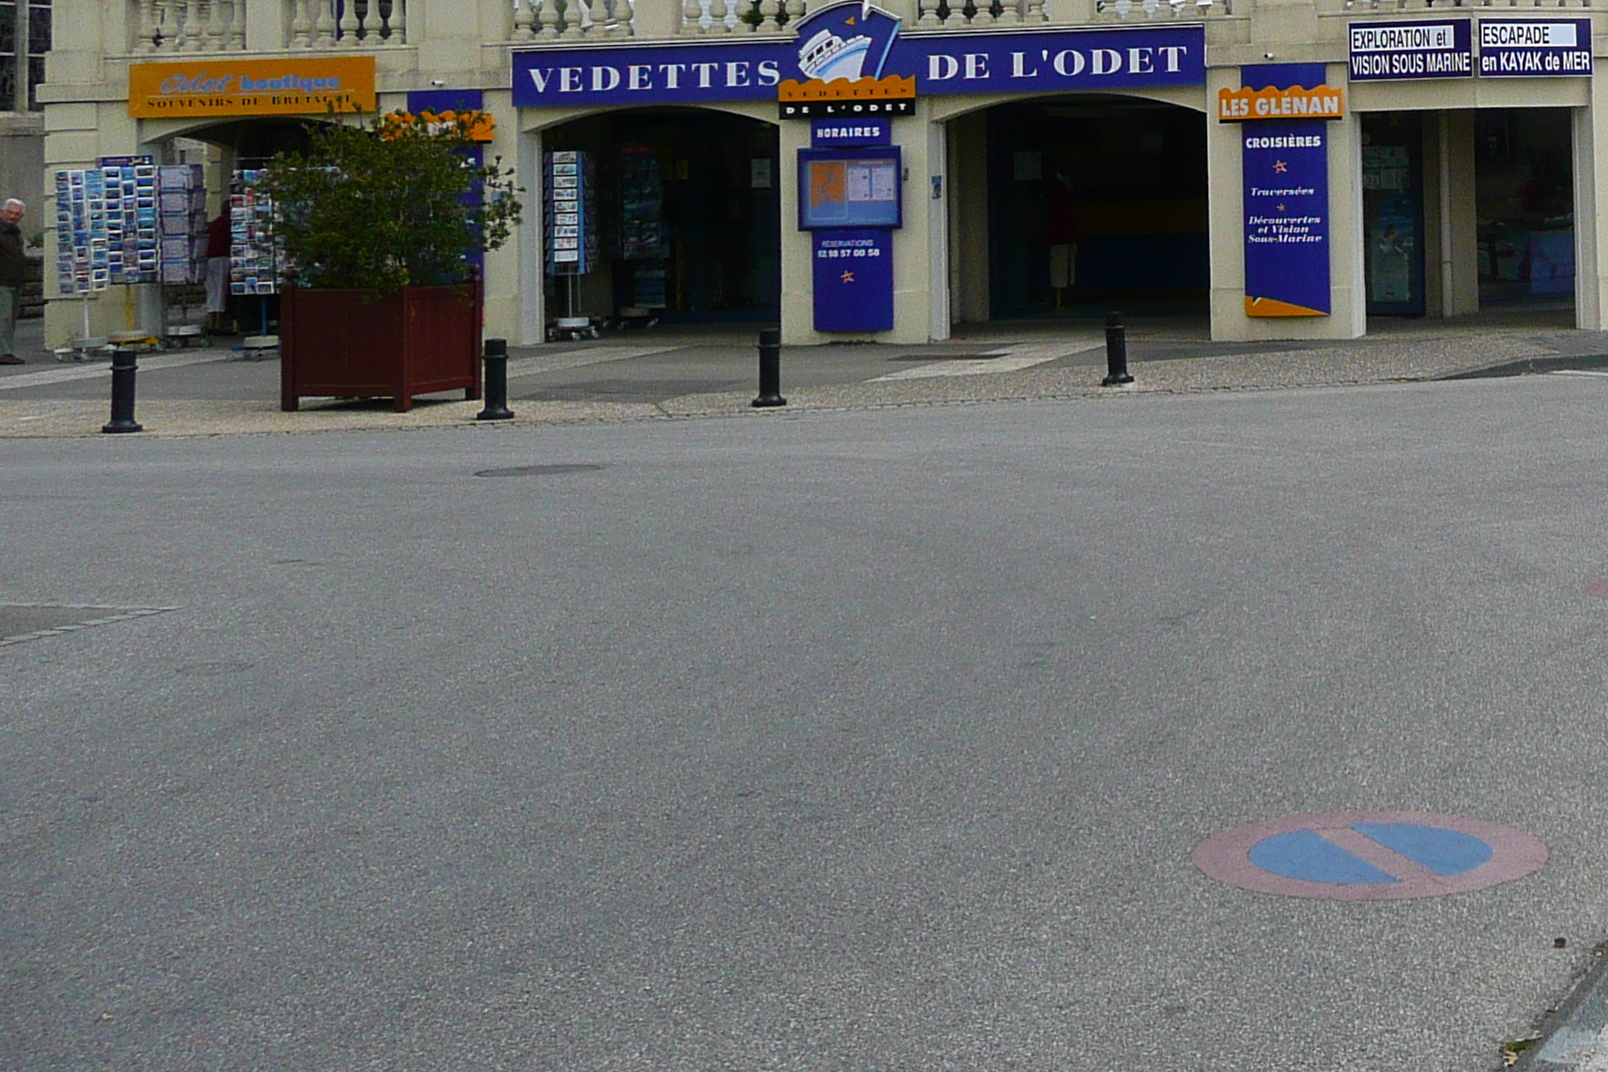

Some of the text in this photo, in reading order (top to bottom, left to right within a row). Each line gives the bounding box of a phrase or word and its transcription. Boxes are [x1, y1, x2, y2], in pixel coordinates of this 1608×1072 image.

[1352, 28, 1447, 49] EXPLORATION et
[1483, 26, 1550, 44] ESCAPADE
[1351, 52, 1470, 75] VISION SOUS MARINE
[1482, 51, 1590, 71] en KAYAK de MER
[528, 46, 1187, 93] VEDETTES DE L'ODET
[160, 70, 340, 94] Odet boutique
[147, 98, 233, 108] SOUVENIRS
[786, 103, 906, 114] DE L'ODET
[1221, 91, 1339, 116] LES GLÉNAN
[817, 127, 880, 138] HORAIRES
[1245, 133, 1321, 148] CROISIÈRES
[1251, 186, 1314, 196] Traversées
[1248, 215, 1321, 224] Découvertes
[1272, 225, 1309, 233] Vision
[840, 249, 851, 257] 57
